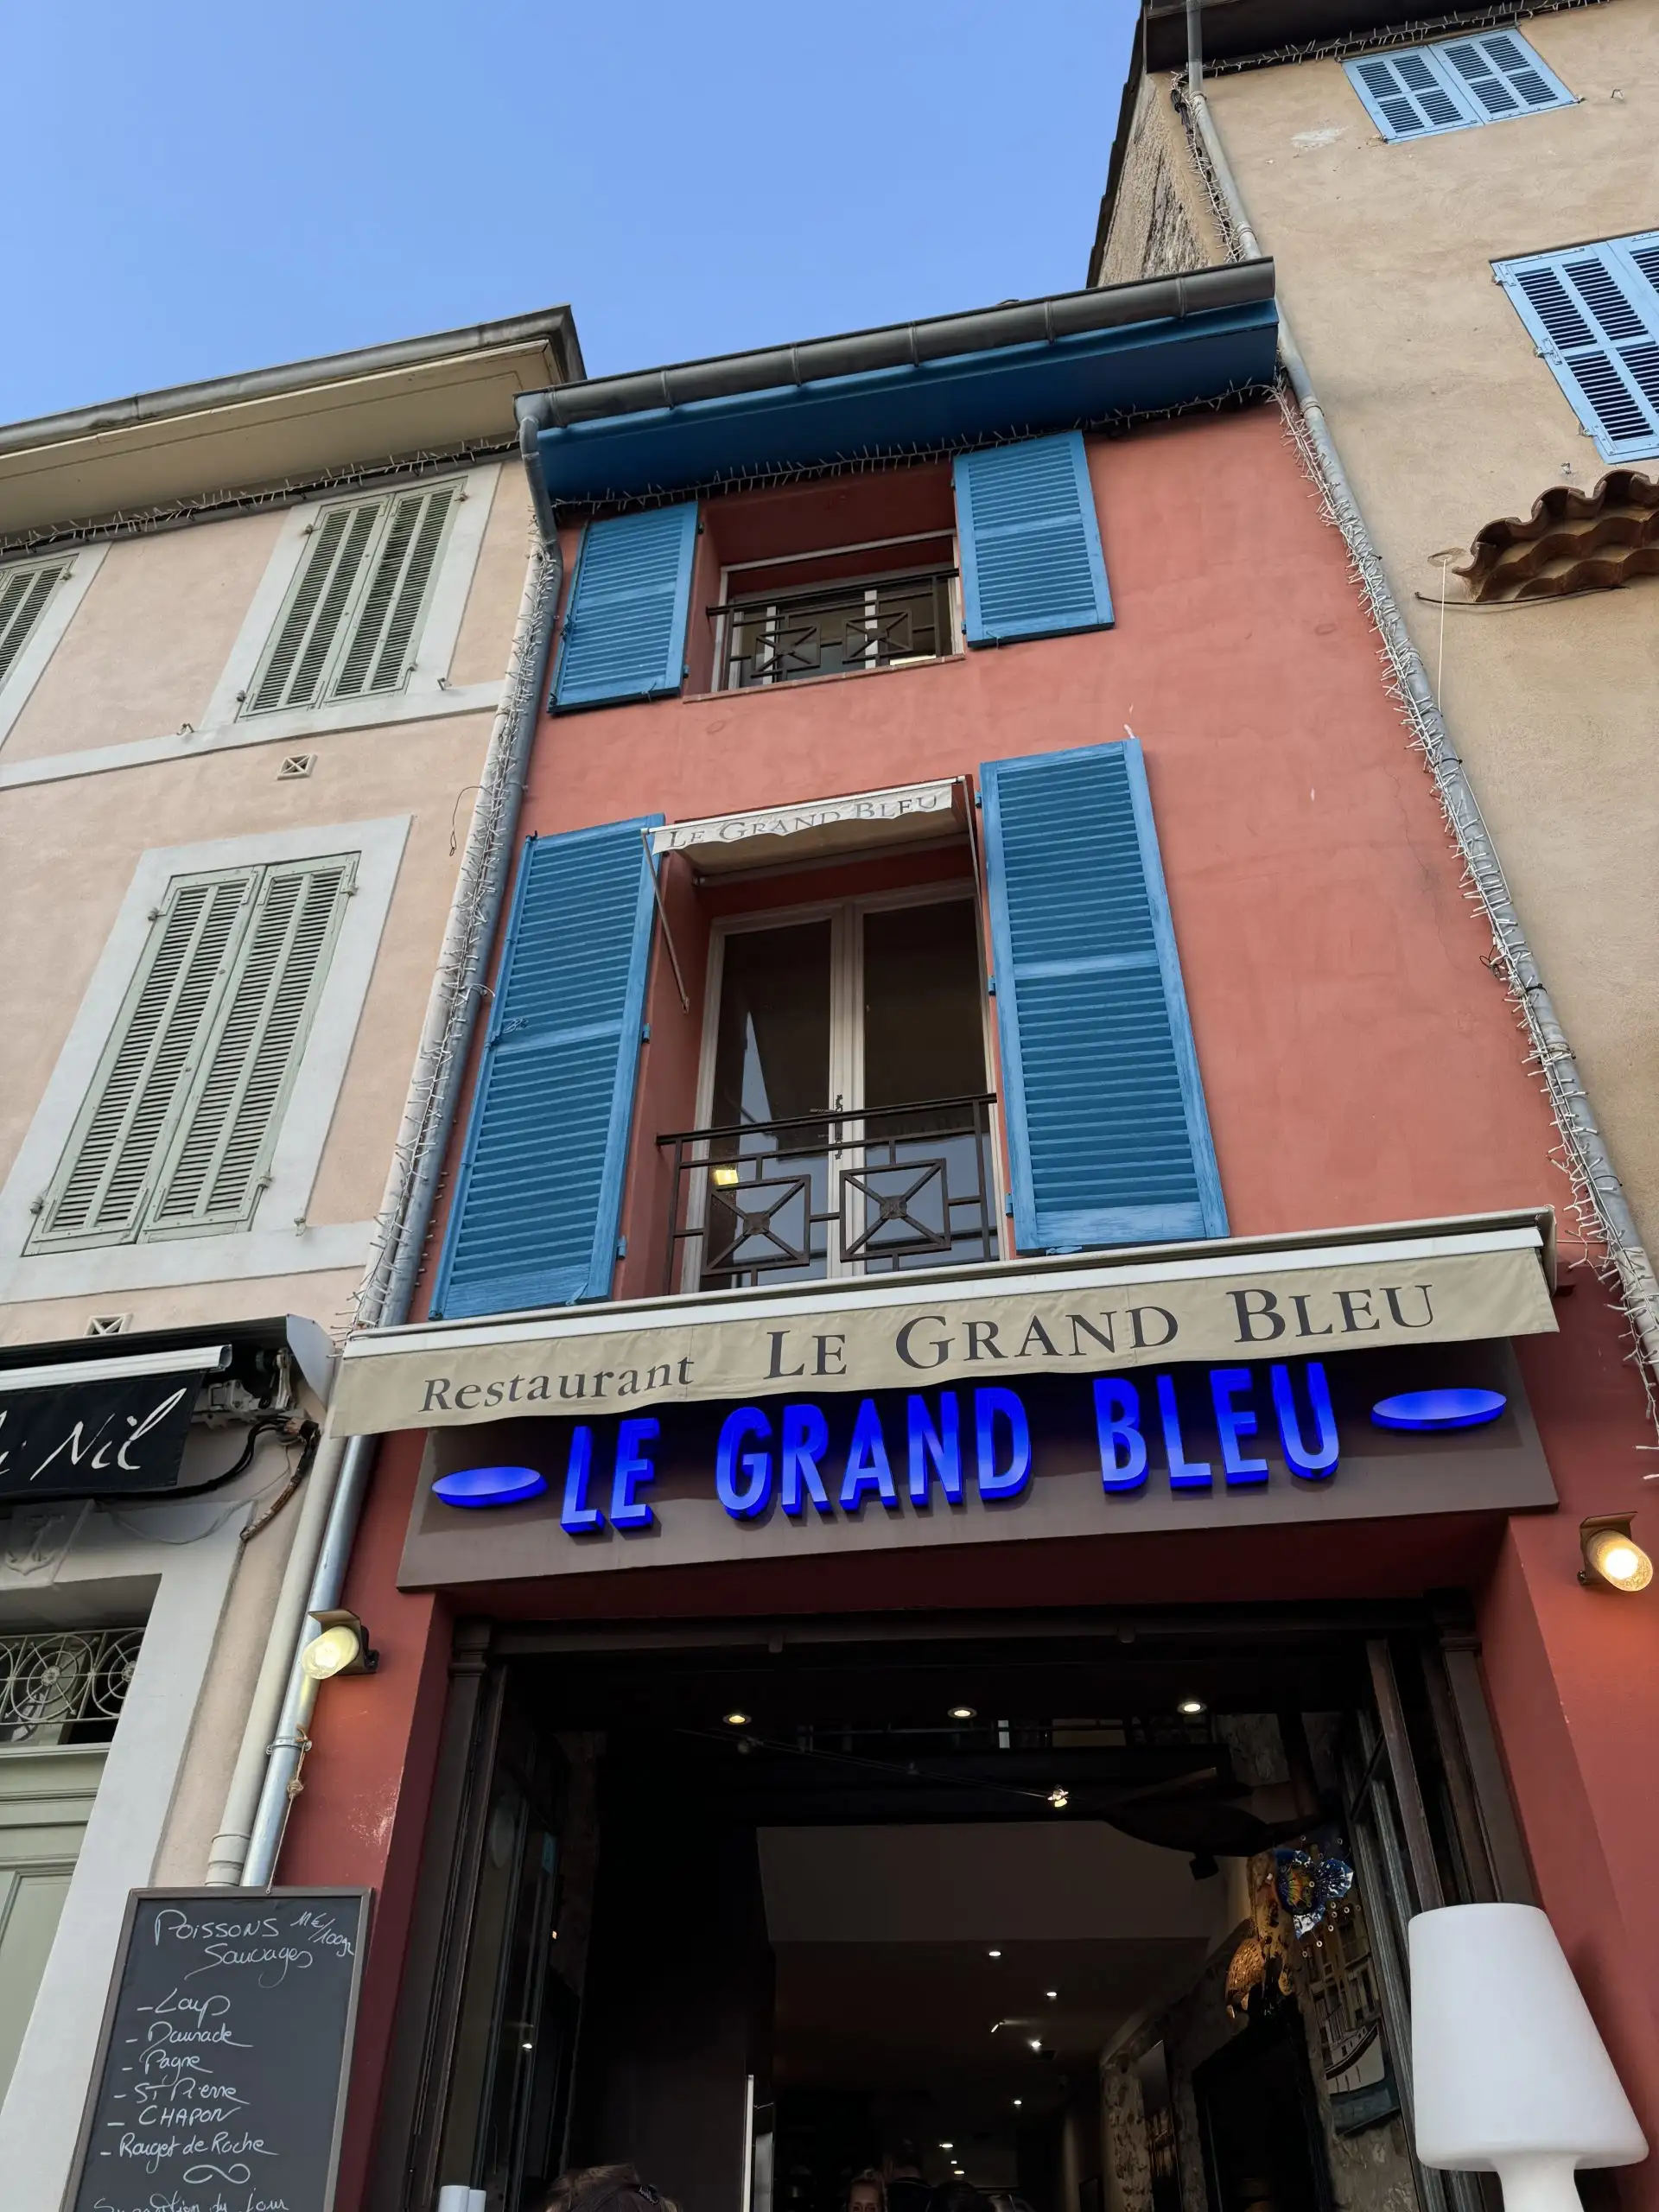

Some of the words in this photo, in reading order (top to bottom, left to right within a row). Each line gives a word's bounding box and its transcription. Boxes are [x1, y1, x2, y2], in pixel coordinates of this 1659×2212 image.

[418, 1354, 695, 1413] Restaurant
[764, 1329, 849, 1380] LE
[895, 1305, 1179, 1370] GRAND
[1225, 1283, 1435, 1344] BLEU
[560, 1417, 661, 1535] LE
[715, 1385, 1033, 1521] GRAND
[1093, 1362, 1340, 1494] BLEU
[183, 1943, 313, 1988] Sauvages
[155, 1988, 231, 2029] Loup
[138, 2105, 242, 2126] CHAPON
[181, 2134, 209, 2156] de
[211, 2131, 280, 2156] Roche
